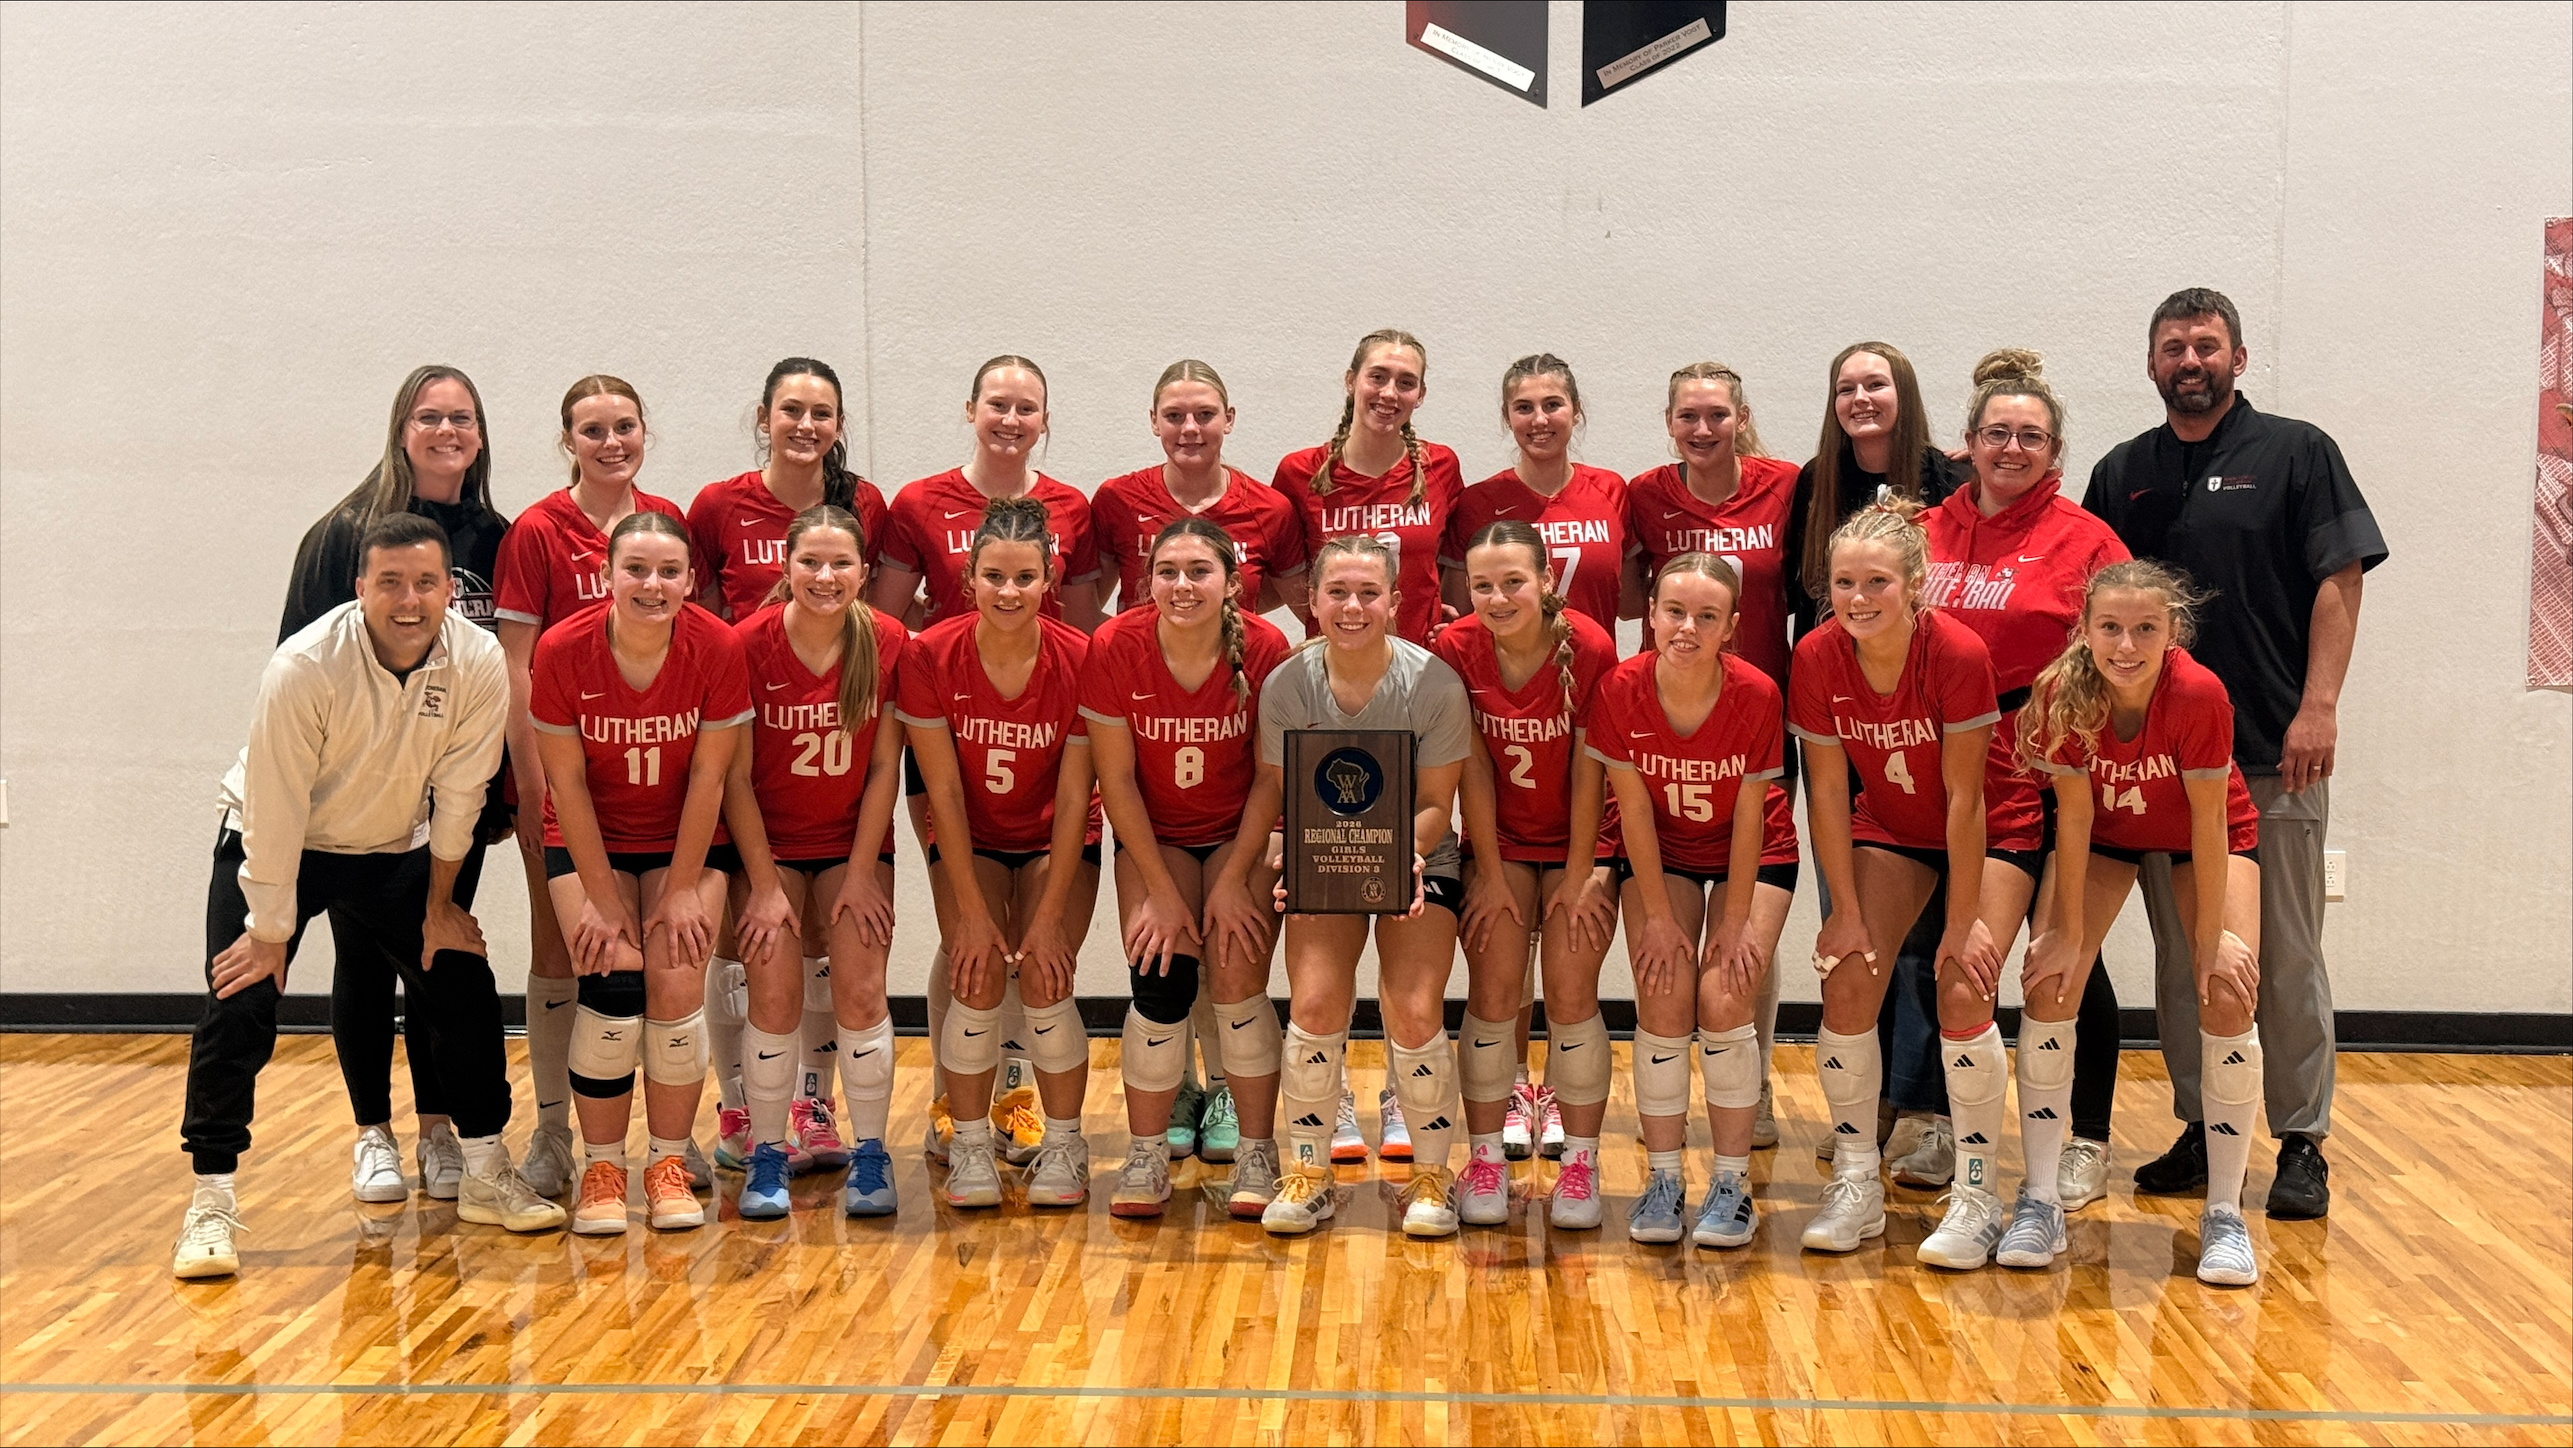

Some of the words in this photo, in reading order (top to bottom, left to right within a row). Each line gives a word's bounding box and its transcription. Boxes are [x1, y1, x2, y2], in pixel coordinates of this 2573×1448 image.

[1612, 54, 1641, 73] MEMORY
[1681, 24, 1701, 37] VOGT
[1321, 502, 1431, 532] LUTHERAN
[1530, 520, 1610, 544] HERAN
[1666, 523, 1773, 552] LUTHERAN
[580, 707, 700, 744] LUTHERAN
[1132, 710, 1247, 742] LUTHERAN
[624, 746, 660, 787] 11
[791, 730, 852, 777] 20
[1175, 746, 1204, 789] 8
[1504, 744, 1536, 789] 2
[985, 749, 1016, 794] 5
[1884, 750, 1916, 794] 4
[1663, 783, 1713, 823] 15
[2102, 783, 2147, 815] 14
[1304, 828, 1347, 844] REGIONAL
[1348, 828, 1394, 844] CHAMPION
[1331, 846, 1366, 854] GIRLS
[1312, 855, 1385, 863] VOLLEYBALL
[1318, 865, 1370, 873] DIVISION
